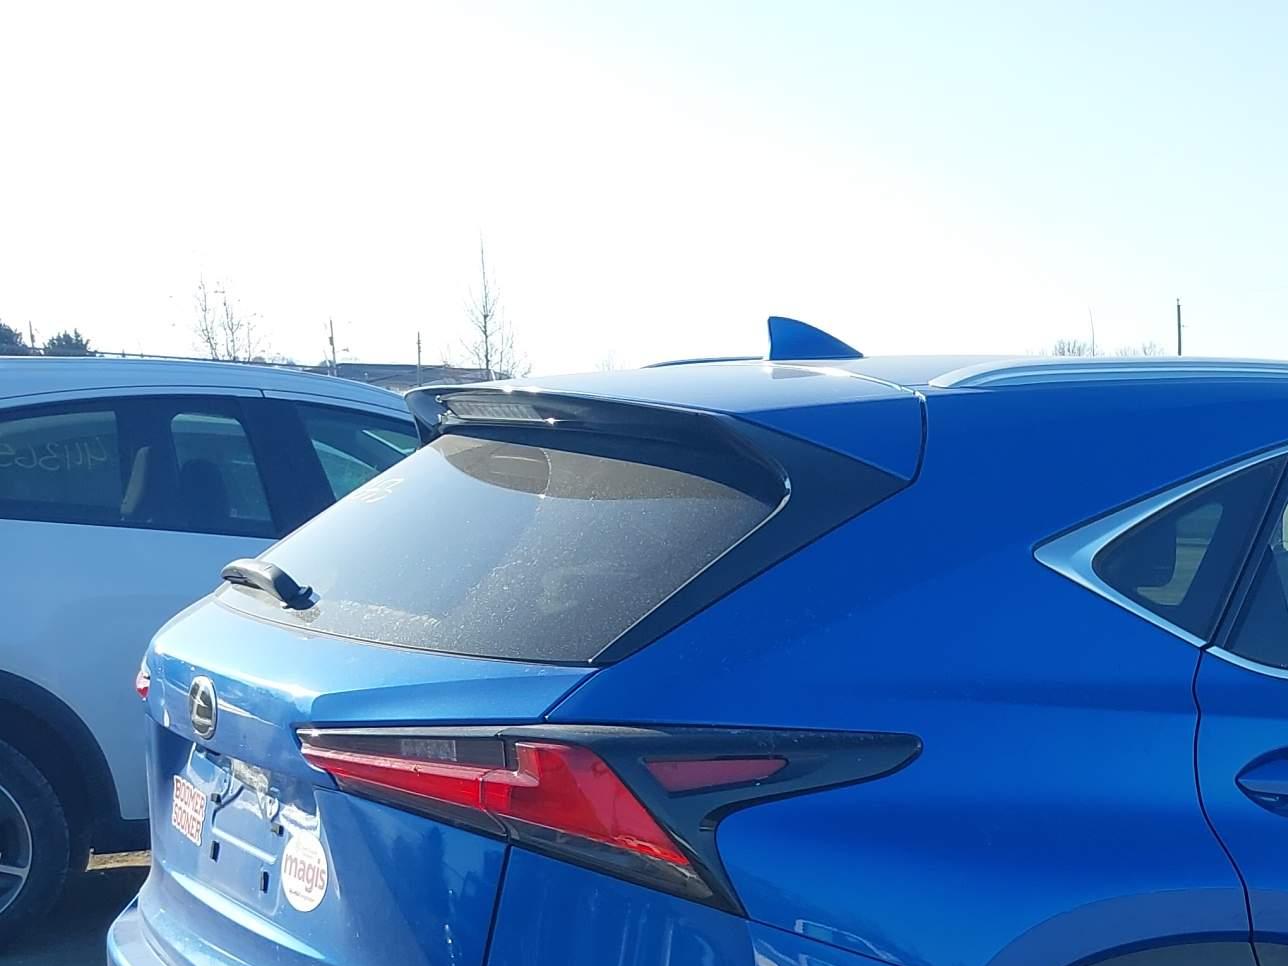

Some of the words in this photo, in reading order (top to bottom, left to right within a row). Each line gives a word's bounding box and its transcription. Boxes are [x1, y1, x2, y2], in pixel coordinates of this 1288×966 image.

[175, 778, 204, 815] BOOMER
[174, 803, 202, 842] SOONER
[284, 853, 326, 893] magis
